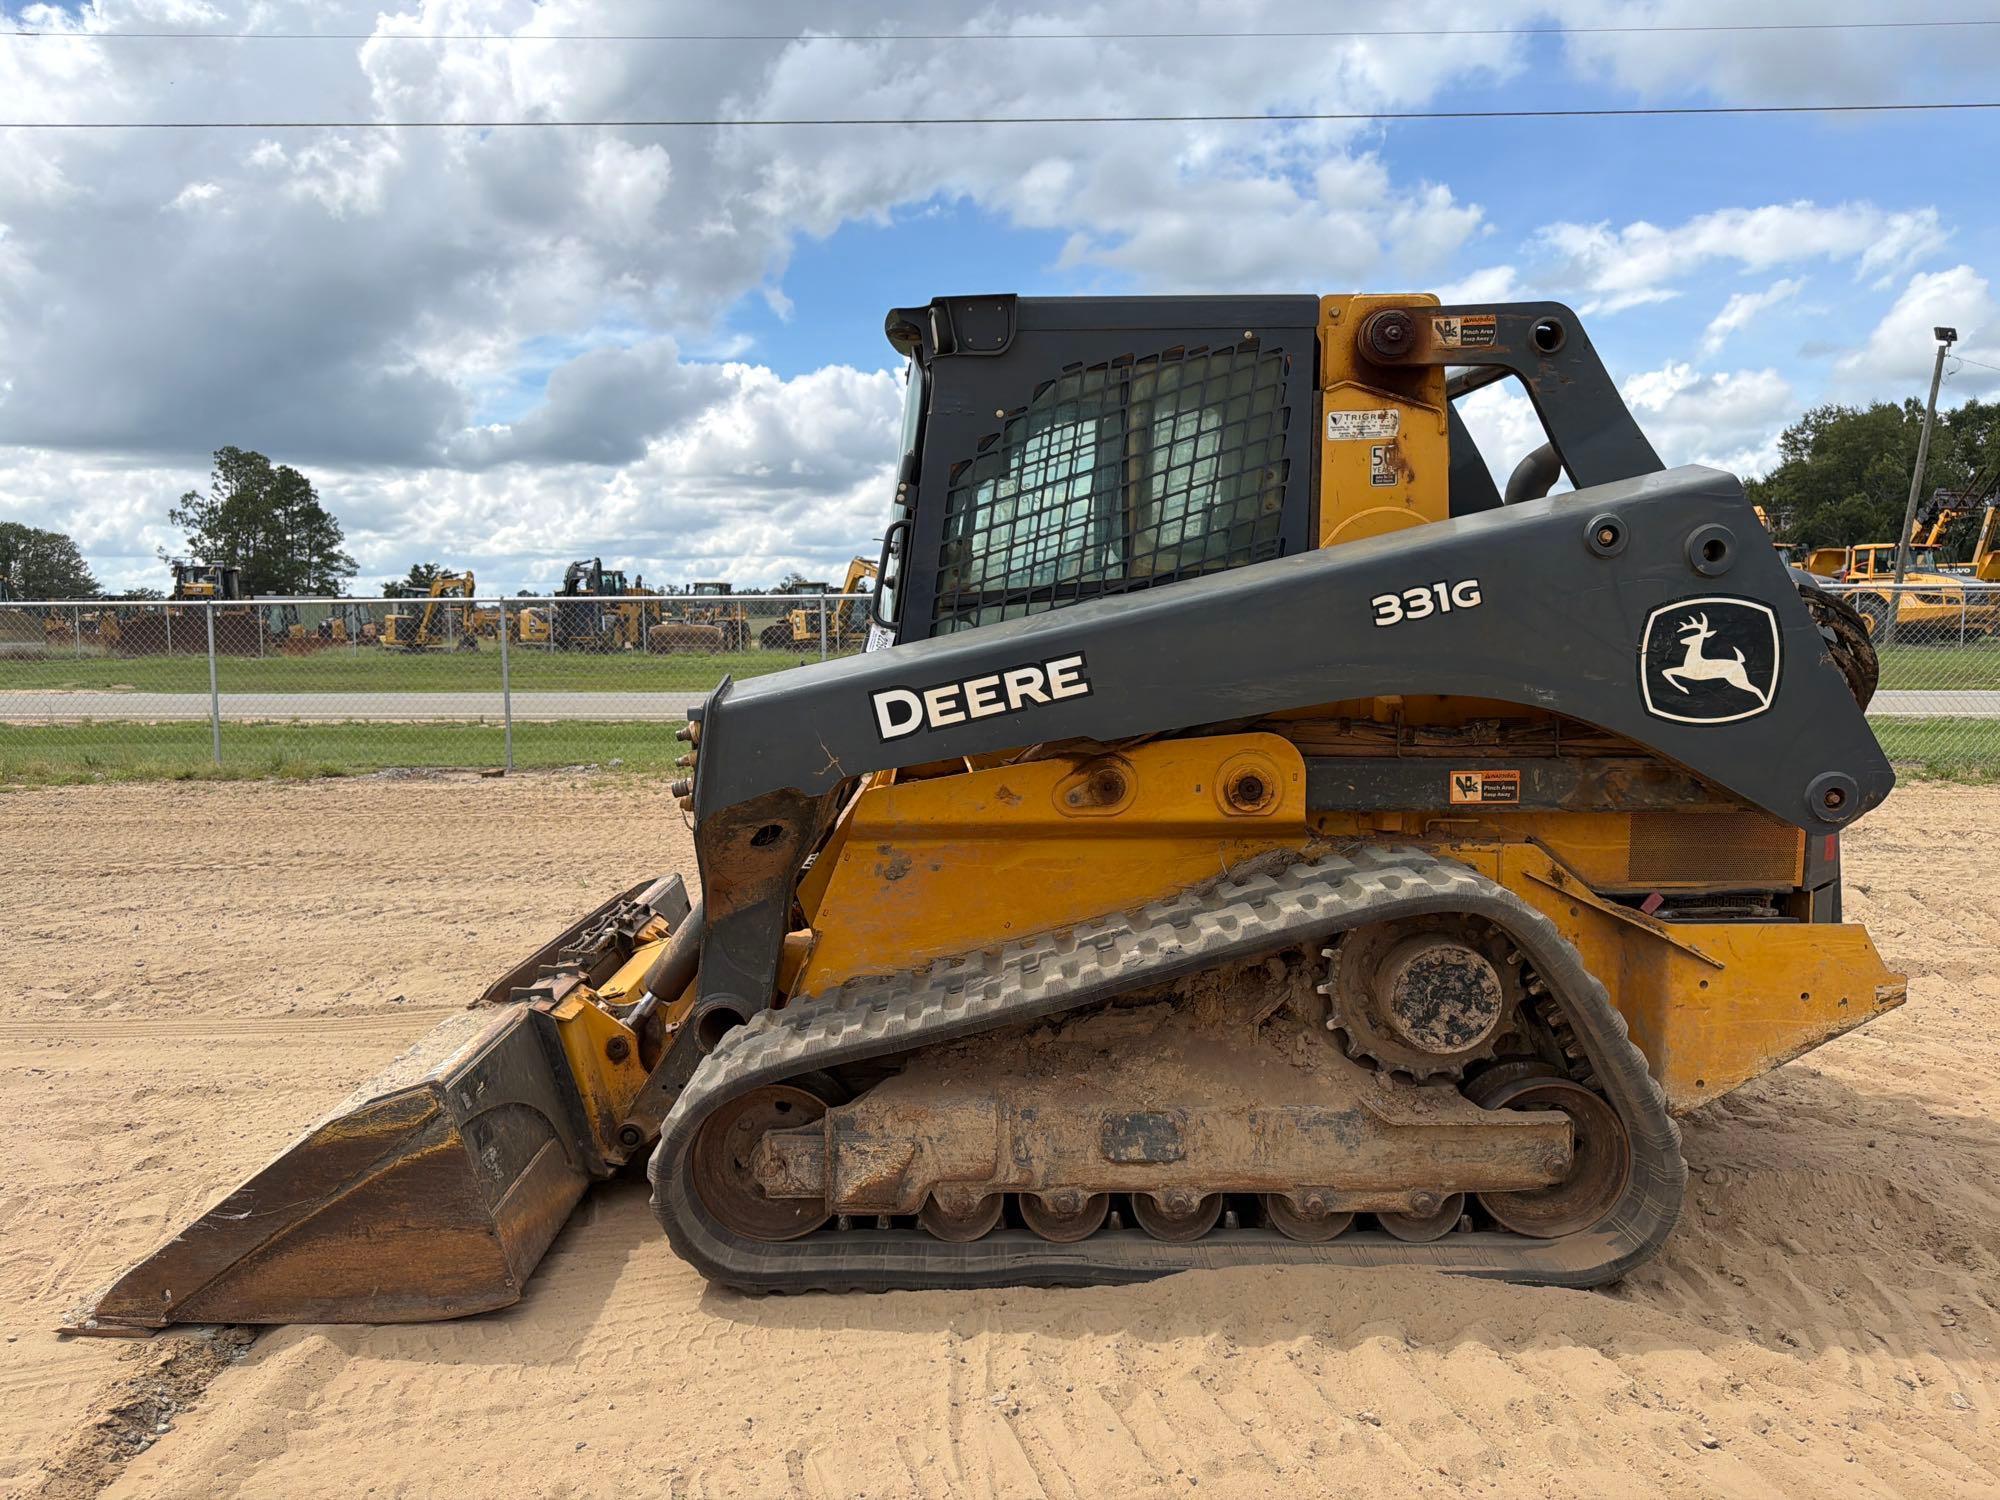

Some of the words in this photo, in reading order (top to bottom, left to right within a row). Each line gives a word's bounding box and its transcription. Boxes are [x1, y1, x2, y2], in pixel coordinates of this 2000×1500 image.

[1344, 412, 1397, 421] TRIGREN
[1371, 579, 1482, 626] 331G
[872, 655, 1089, 740] DEERE
